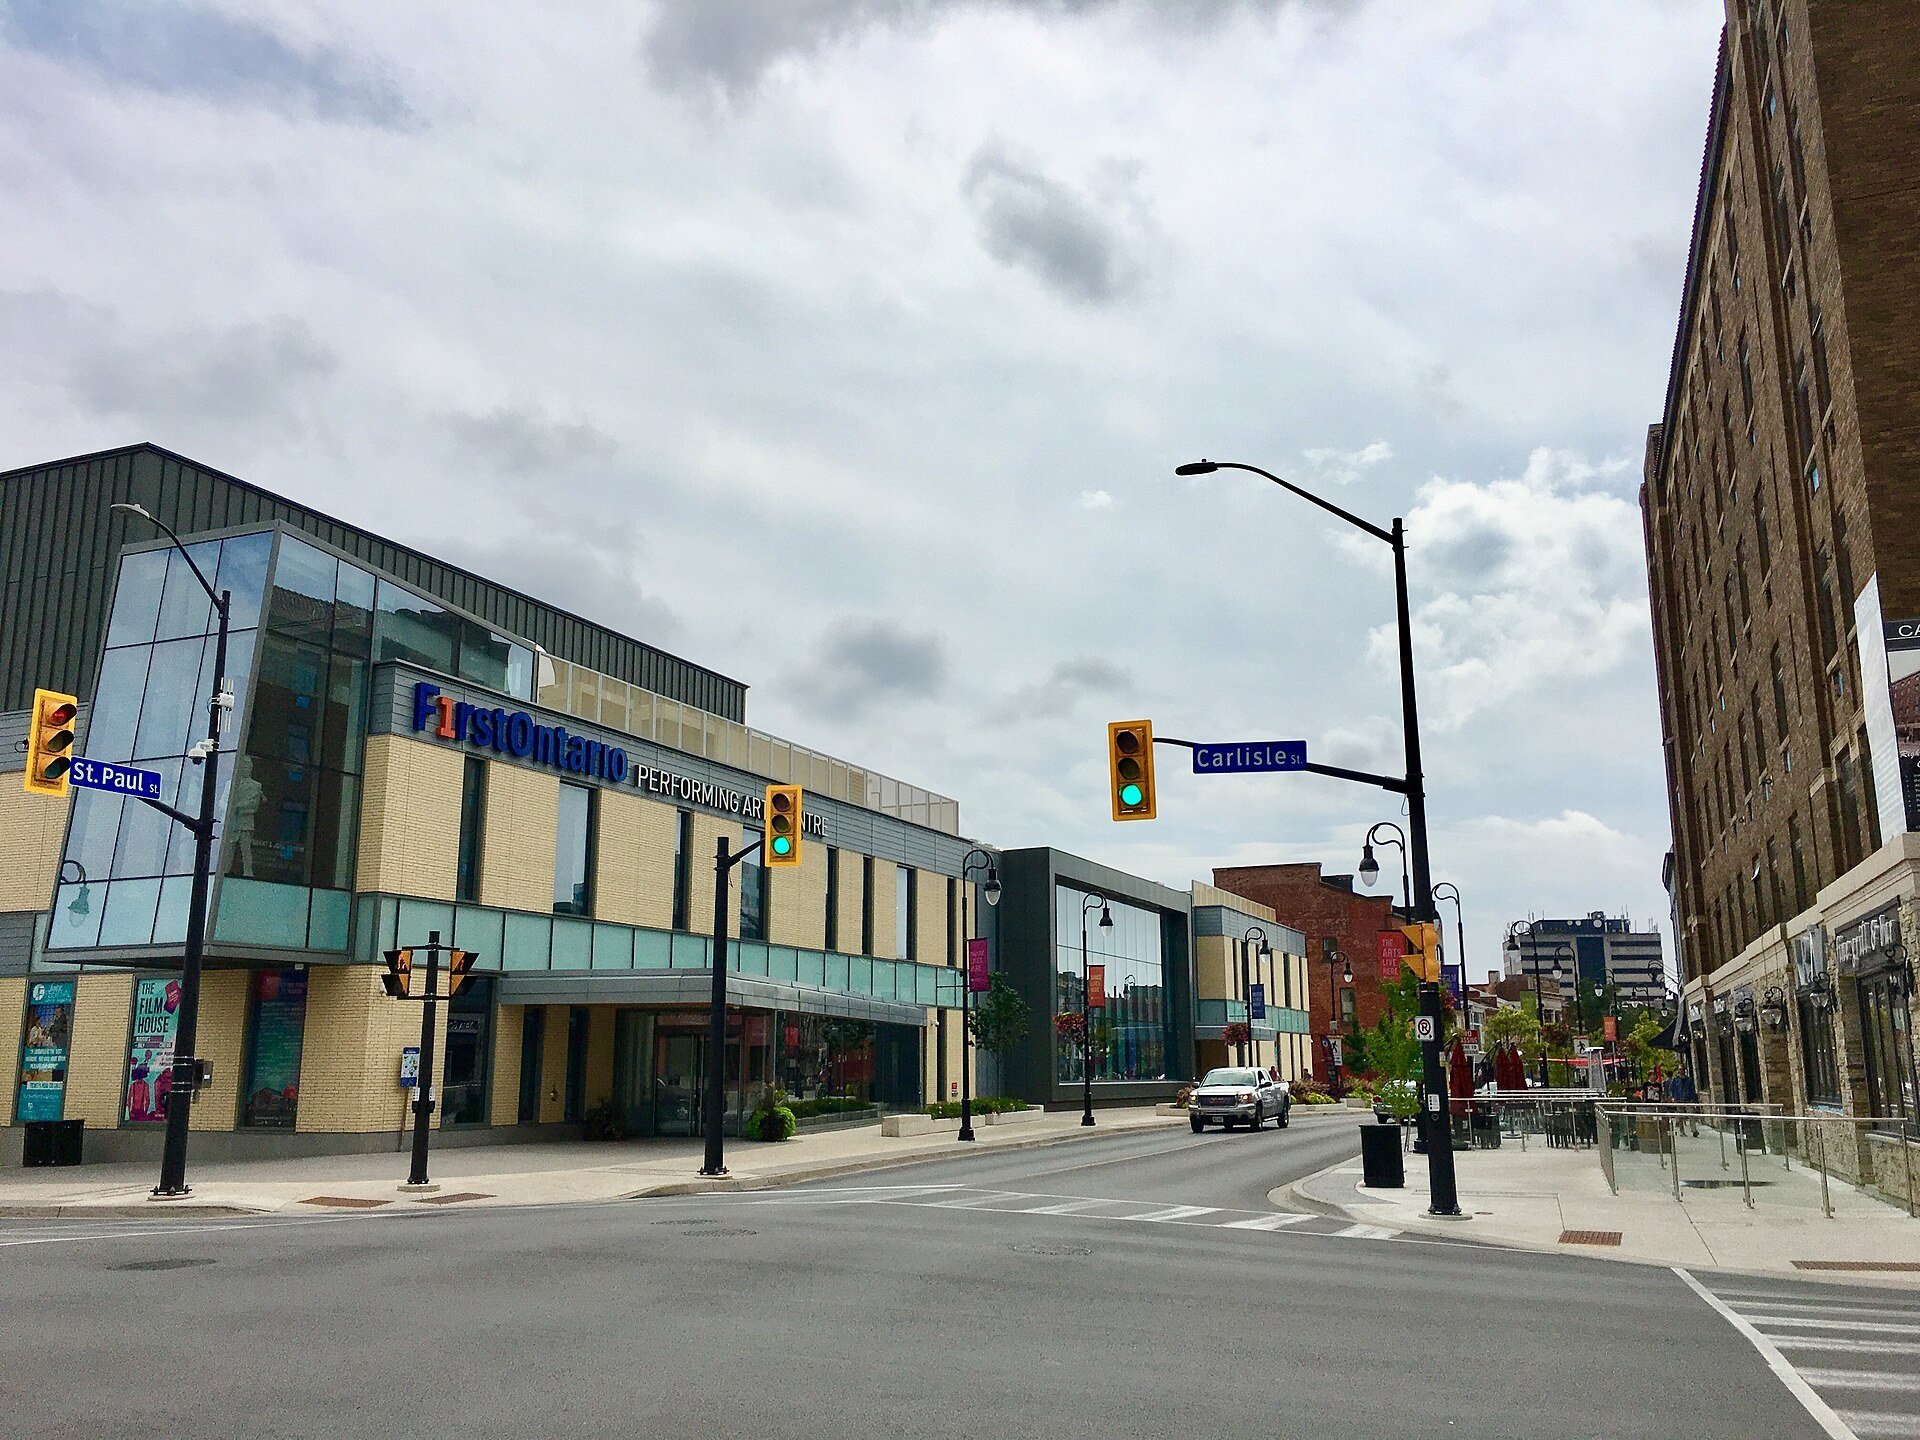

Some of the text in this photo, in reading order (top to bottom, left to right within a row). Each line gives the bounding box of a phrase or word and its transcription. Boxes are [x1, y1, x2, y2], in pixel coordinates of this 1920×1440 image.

[1197, 746, 1303, 768] Carlisle St.
[73, 762, 160, 794] St. Paul St.
[637, 764, 739, 813] PERFORMING
[742, 797, 767, 821] ART
[1382, 948, 1401, 958] ARTS
[141, 982, 155, 995] THE
[140, 997, 164, 1015] FILM
[137, 1016, 170, 1034] HOUSE
